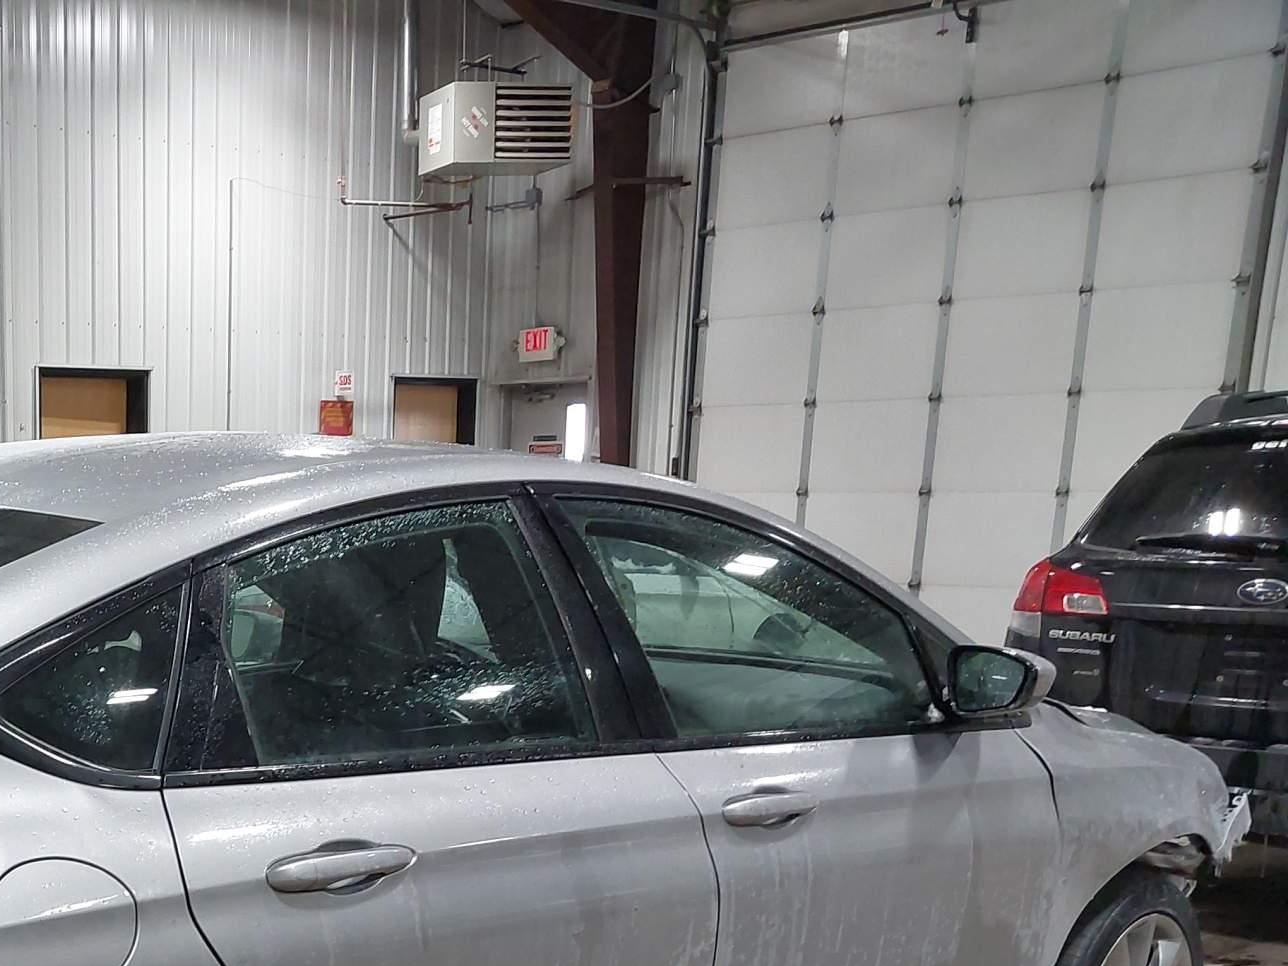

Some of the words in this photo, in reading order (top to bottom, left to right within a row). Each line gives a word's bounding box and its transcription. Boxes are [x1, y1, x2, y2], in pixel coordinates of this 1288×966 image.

[525, 329, 549, 352] EXIT
[339, 374, 352, 386] SDS
[1048, 629, 1116, 643] SUBARU
